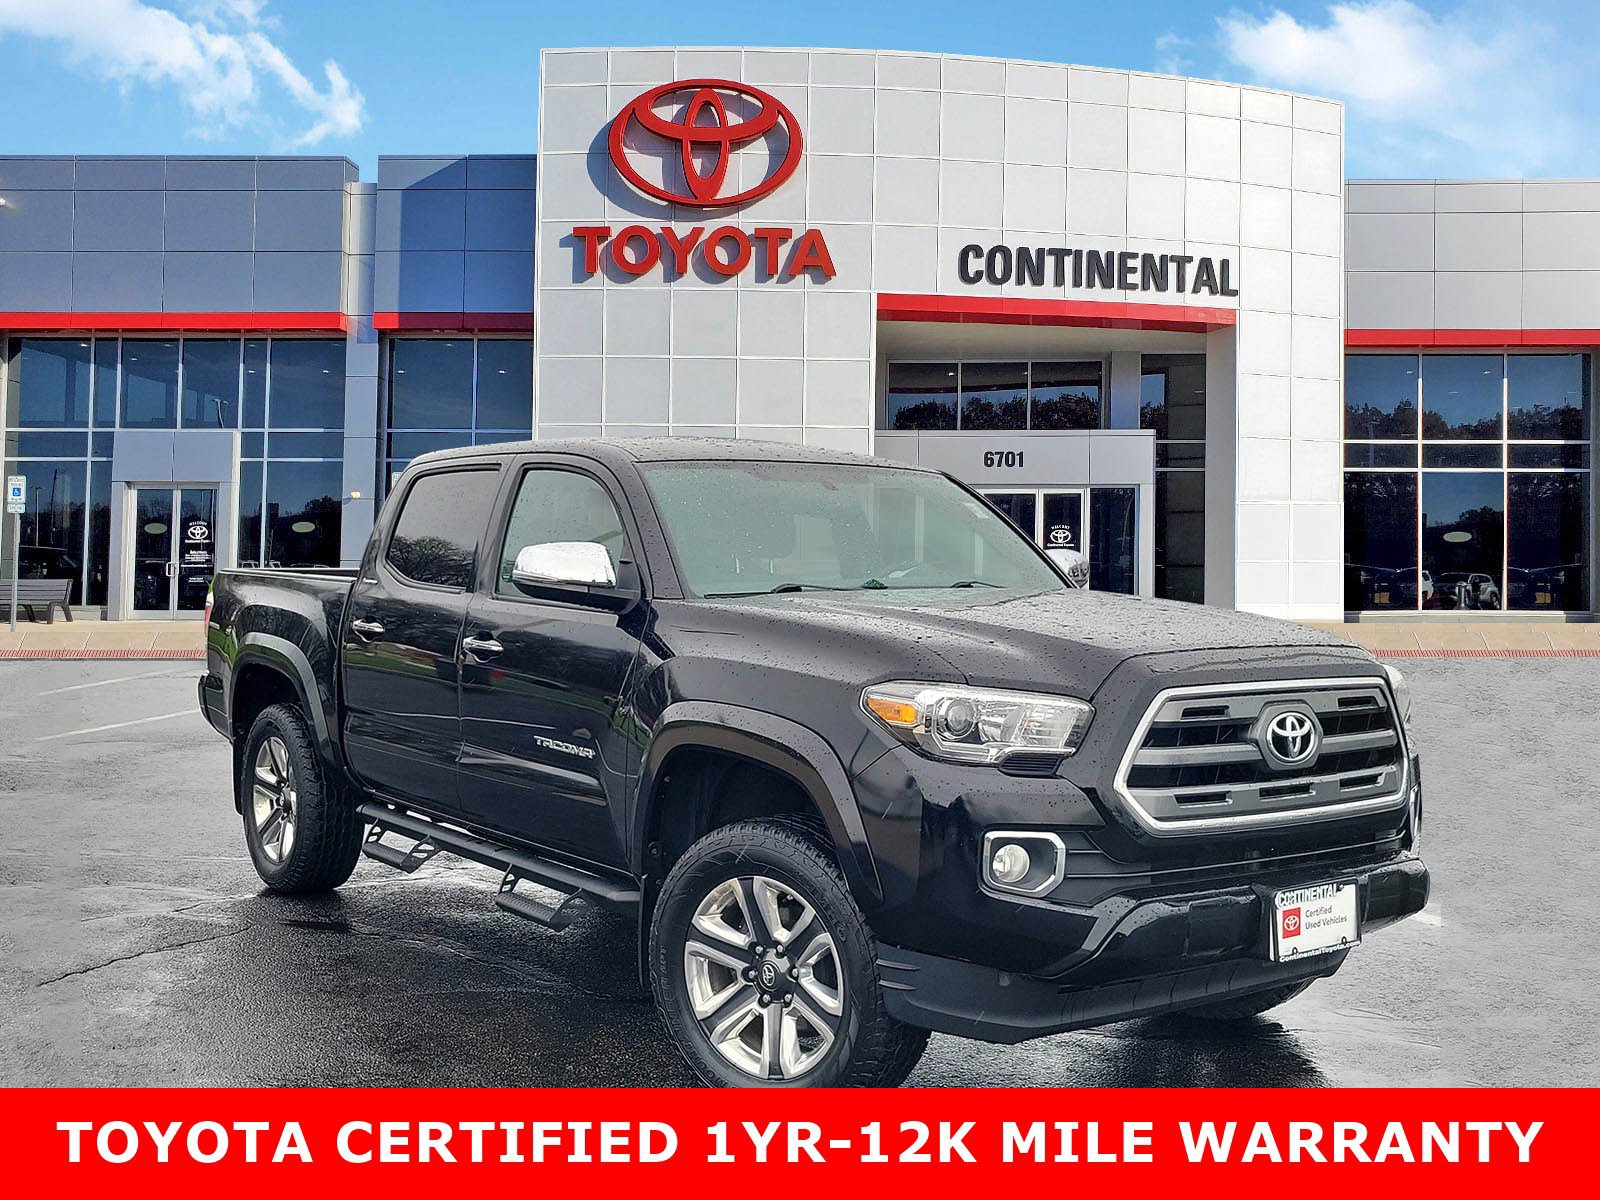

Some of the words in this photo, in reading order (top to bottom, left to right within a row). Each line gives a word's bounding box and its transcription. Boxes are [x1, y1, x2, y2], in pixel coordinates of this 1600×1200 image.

[572, 225, 836, 276] TOYOTA
[958, 244, 1239, 297] CONTINENTAL
[983, 451, 1024, 468] 6701
[533, 735, 596, 759] TACOMA
[1276, 883, 1337, 907] CONTINENTAL
[1305, 905, 1333, 918] Certified
[1305, 920, 1321, 930] Used
[1322, 915, 1348, 927] Vehicles
[1279, 940, 1361, 963] ContinentalToyota.com
